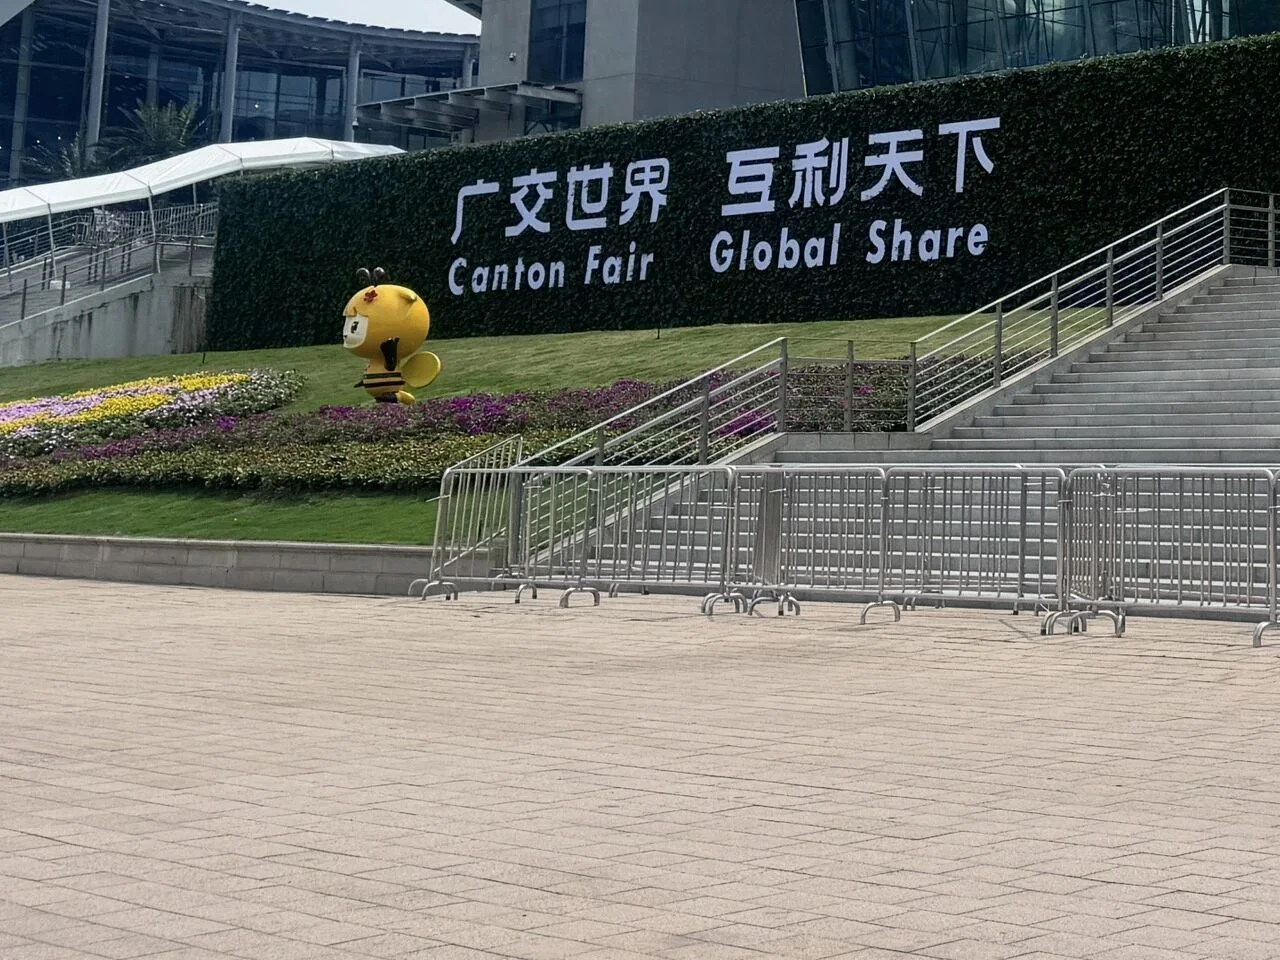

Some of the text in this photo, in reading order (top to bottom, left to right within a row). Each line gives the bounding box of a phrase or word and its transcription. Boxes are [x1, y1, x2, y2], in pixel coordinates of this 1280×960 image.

[449, 116, 1001, 246] 广交世界 互利天下
[447, 218, 989, 297] Canton Fair Global Share
